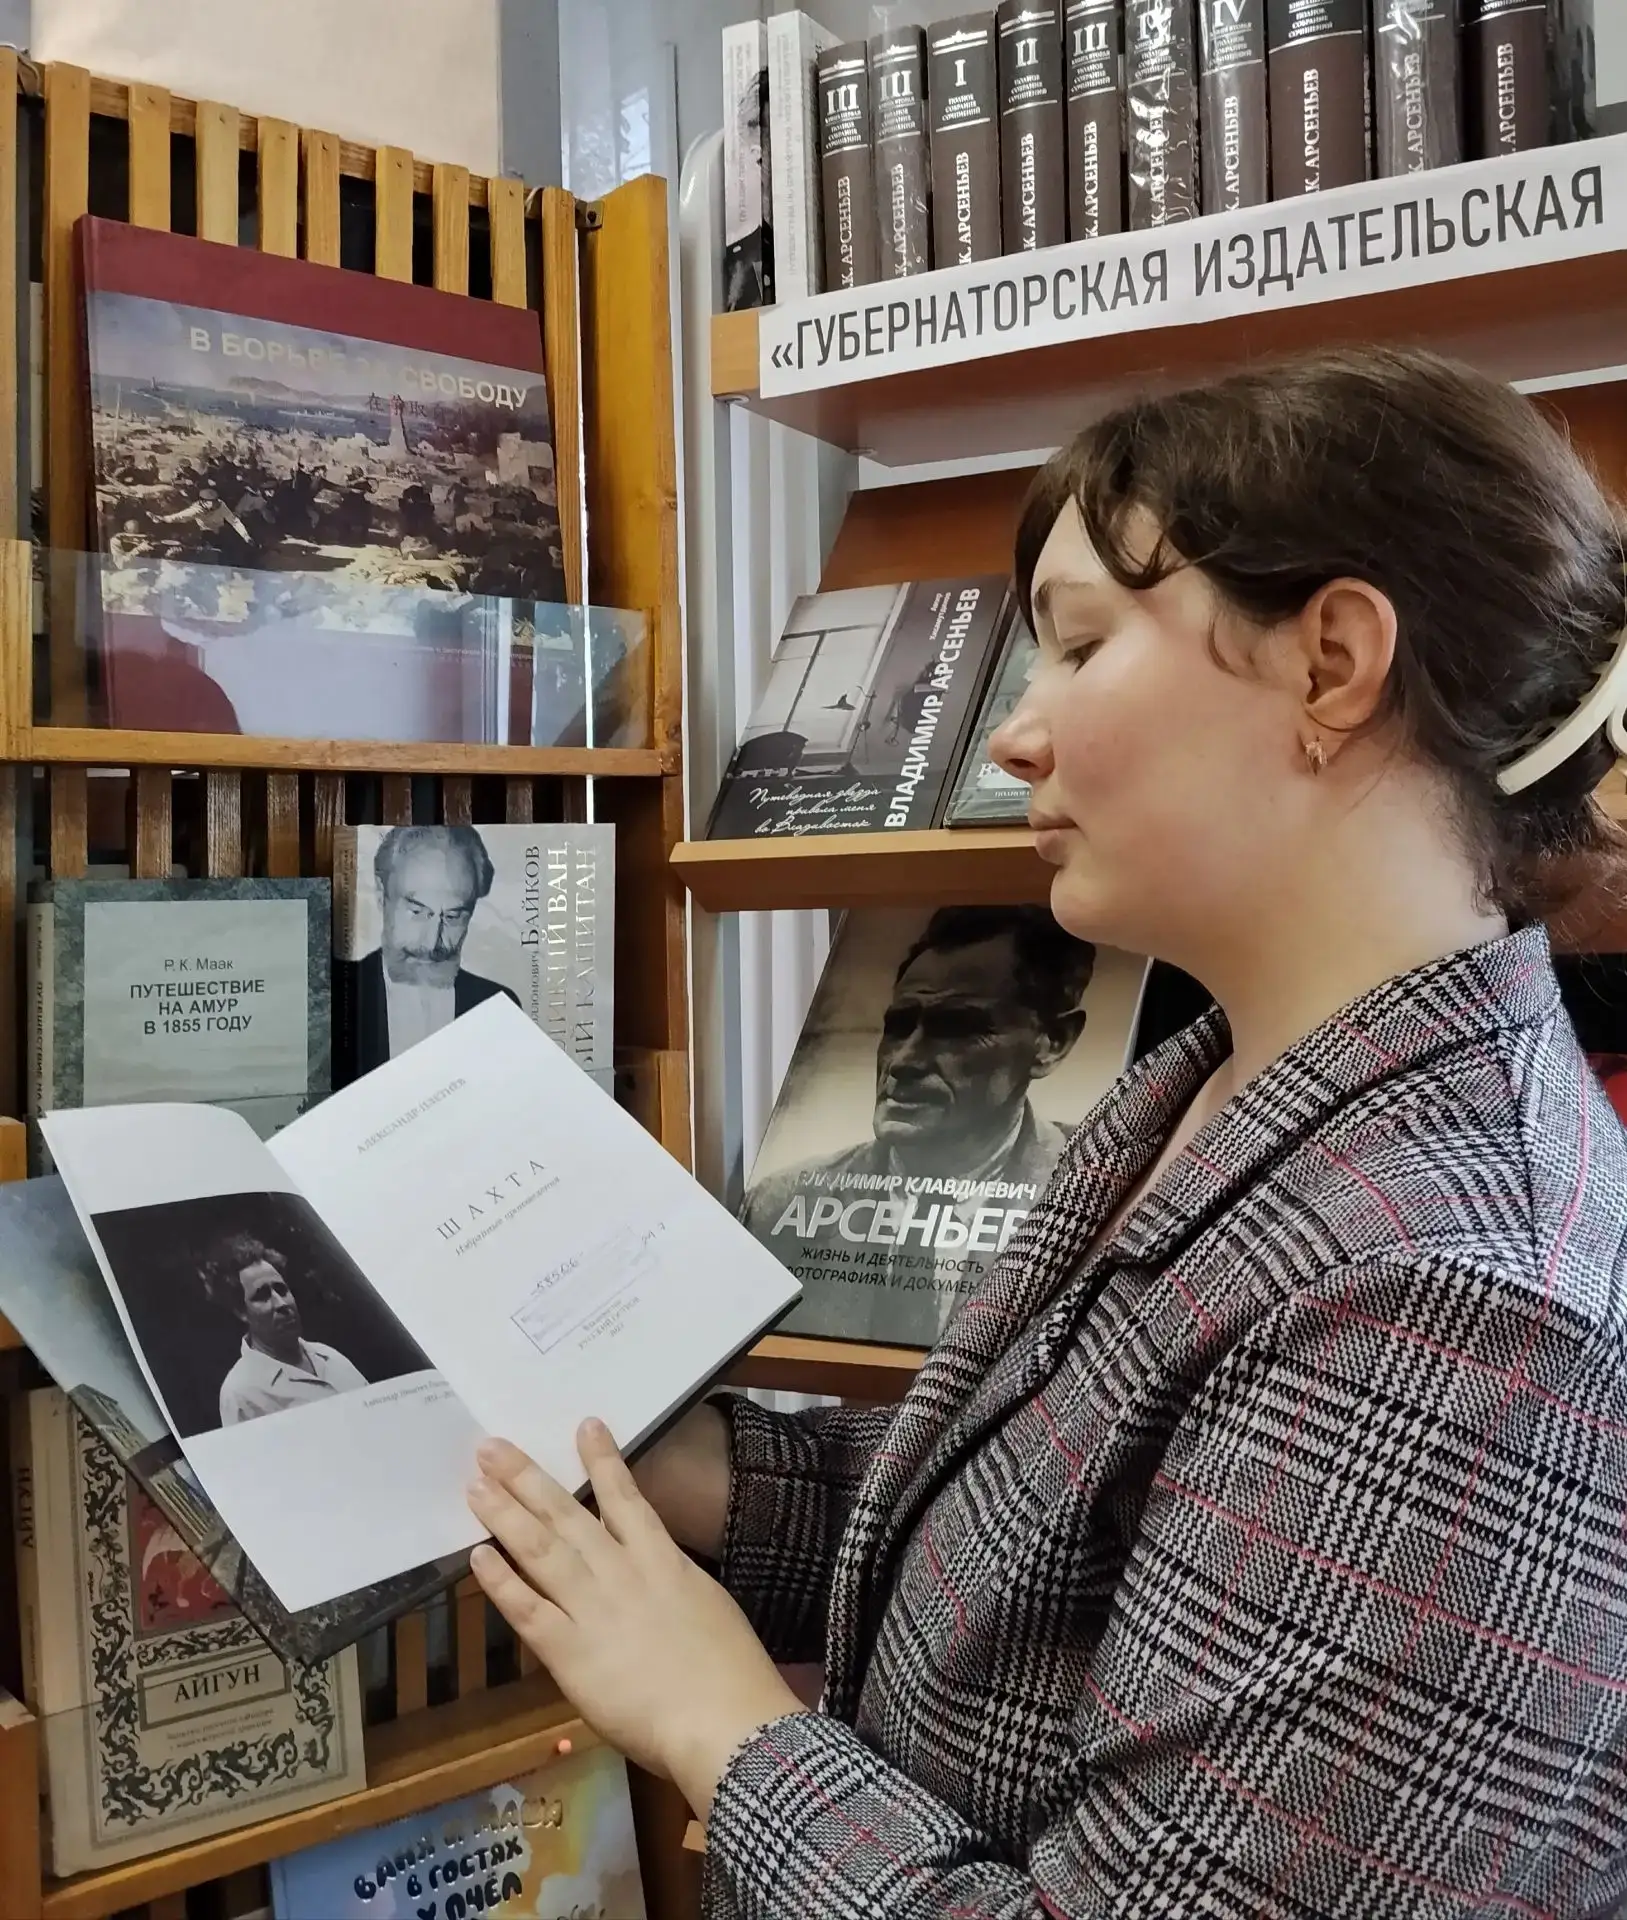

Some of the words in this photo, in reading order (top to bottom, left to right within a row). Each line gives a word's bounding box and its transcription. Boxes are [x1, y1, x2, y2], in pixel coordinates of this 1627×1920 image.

[1016, 38, 1038, 68] II
[1073, 22, 1108, 56] III
[880, 70, 913, 101] III
[955, 59, 967, 87] I
[827, 84, 859, 115] III
[1304, 69, 1319, 168] АРСЕНЬЕВ
[1225, 96, 1239, 194] АРСЕНЬЕВ
[1021, 133, 1036, 228] АРСЕНЬЕВ
[1084, 121, 1098, 217] АРСЕНЬЕВ
[891, 163, 906, 255] АРСЕНЬЕВ
[956, 152, 971, 245] АРСЕНЬЕВ
[838, 176, 853, 265] АРСЕНЬЕВ
[771, 249, 1168, 370] «ГУБЕРНАТОРСКАЯ
[1195, 165, 1603, 297] ИЗДАТЕЛЬСКАЯ
[190, 327, 211, 351] В
[403, 362, 527, 411] СВОБОДУ
[884, 694, 943, 828] ВЛАДИМИР
[930, 587, 980, 691] АРСЕНЬЕВ
[180, 959, 192, 971] К.
[196, 958, 234, 971] Маак
[130, 979, 265, 998] ПУТЕШЕСТВИЕ
[158, 1001, 183, 1015] НА
[189, 998, 239, 1014] АМУР
[144, 1020, 156, 1034] В
[163, 1018, 200, 1033] 1855
[207, 1015, 252, 1032] ГОДУ
[435, 1159, 545, 1241] ШАХТА
[904, 1177, 1038, 1200] КЛАВДИЕВИЧ
[801, 1247, 851, 1264] ЖИЗНЬ
[854, 1251, 865, 1263] И
[866, 1252, 985, 1275] ДЕЯТЕЛЬНОСТЬ
[890, 1274, 901, 1287] И
[903, 1275, 980, 1295] ДОКУМЕН
[174, 1664, 260, 1703] АЙГУН
[429, 1836, 523, 1891] ГОСТЯХ
